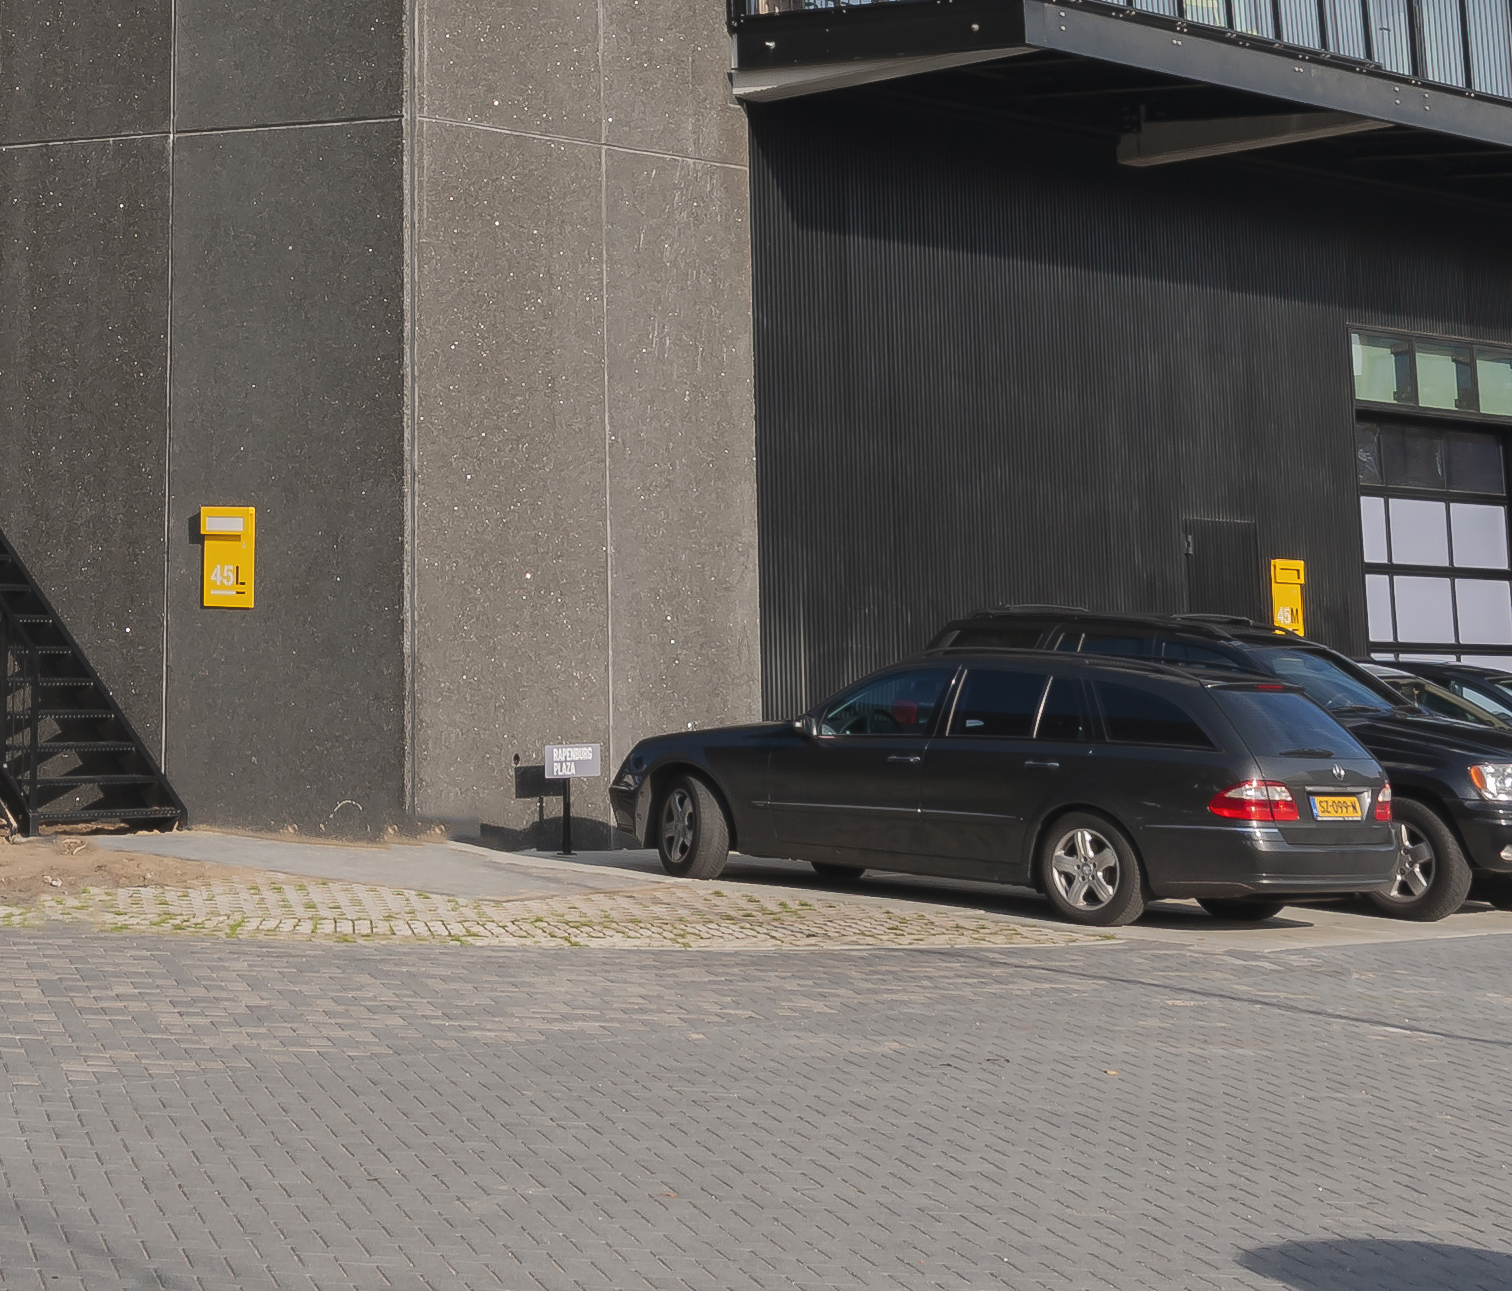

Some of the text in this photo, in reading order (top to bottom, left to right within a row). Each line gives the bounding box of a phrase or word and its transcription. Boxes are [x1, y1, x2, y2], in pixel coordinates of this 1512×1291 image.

[210, 564, 246, 586] 45L
[1277, 606, 1299, 624] 45M
[553, 762, 576, 776] PLAZA
